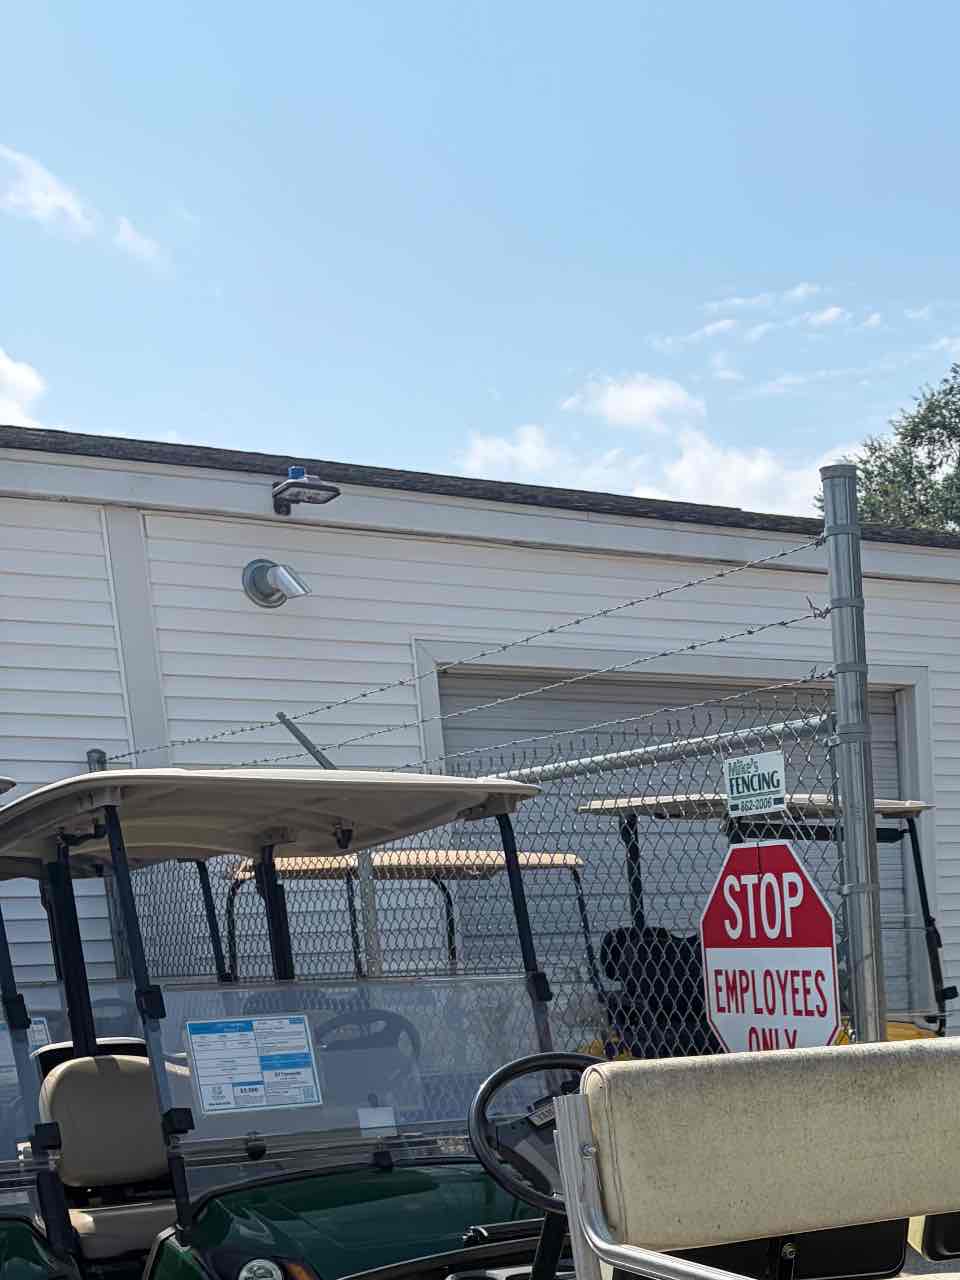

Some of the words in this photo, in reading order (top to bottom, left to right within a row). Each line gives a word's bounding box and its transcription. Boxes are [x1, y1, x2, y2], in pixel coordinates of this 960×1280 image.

[729, 770, 780, 795] FENCING
[723, 872, 804, 940] STOP
[714, 969, 828, 1018] EMPLOYEES
